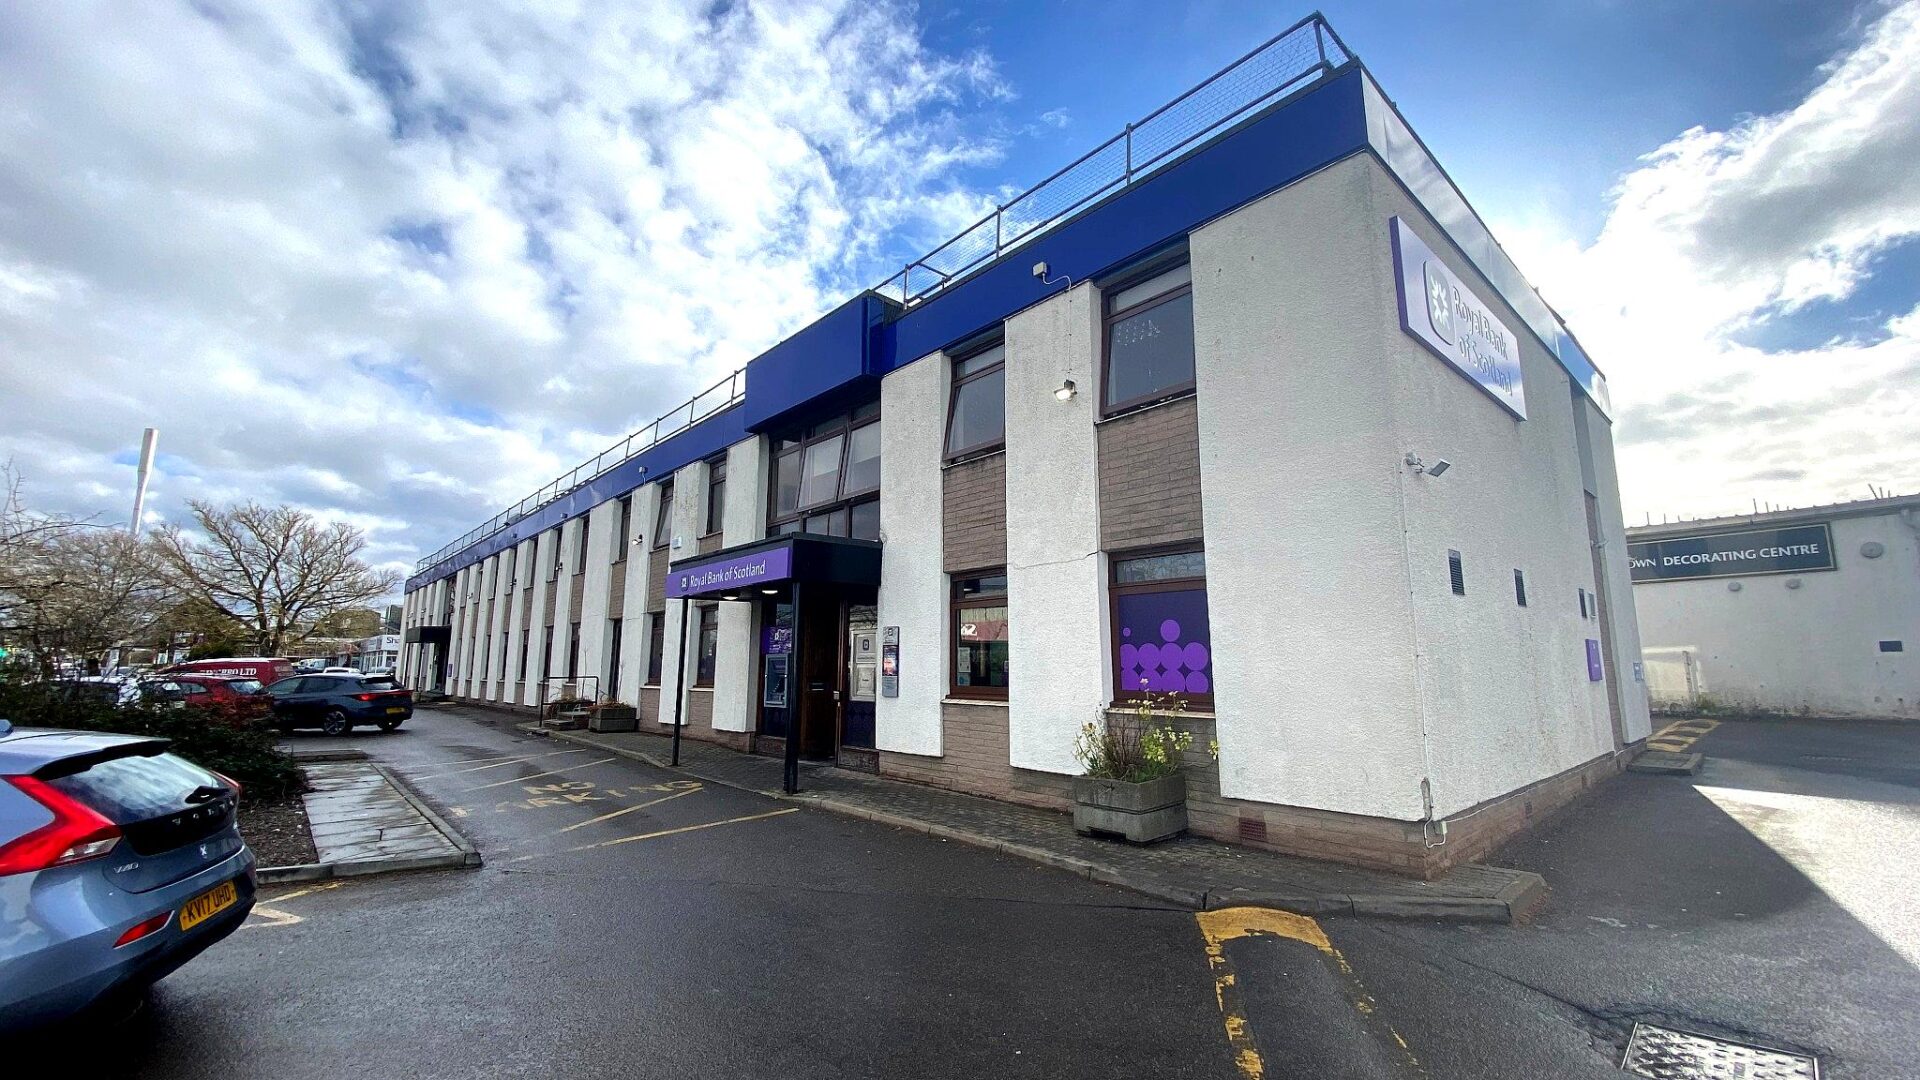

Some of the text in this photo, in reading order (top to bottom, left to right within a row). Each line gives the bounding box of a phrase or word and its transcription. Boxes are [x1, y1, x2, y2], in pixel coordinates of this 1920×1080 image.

[1453, 286, 1508, 361] Royal Bank
[1460, 334, 1513, 396] of Scotland
[1629, 544, 1820, 569] OWN DECORATING CENTRE
[690, 559, 766, 590] Royal Bank of Scotland
[239, 668, 257, 676] LTD
[522, 782, 596, 795] NO
[186, 894, 211, 922] KV17
